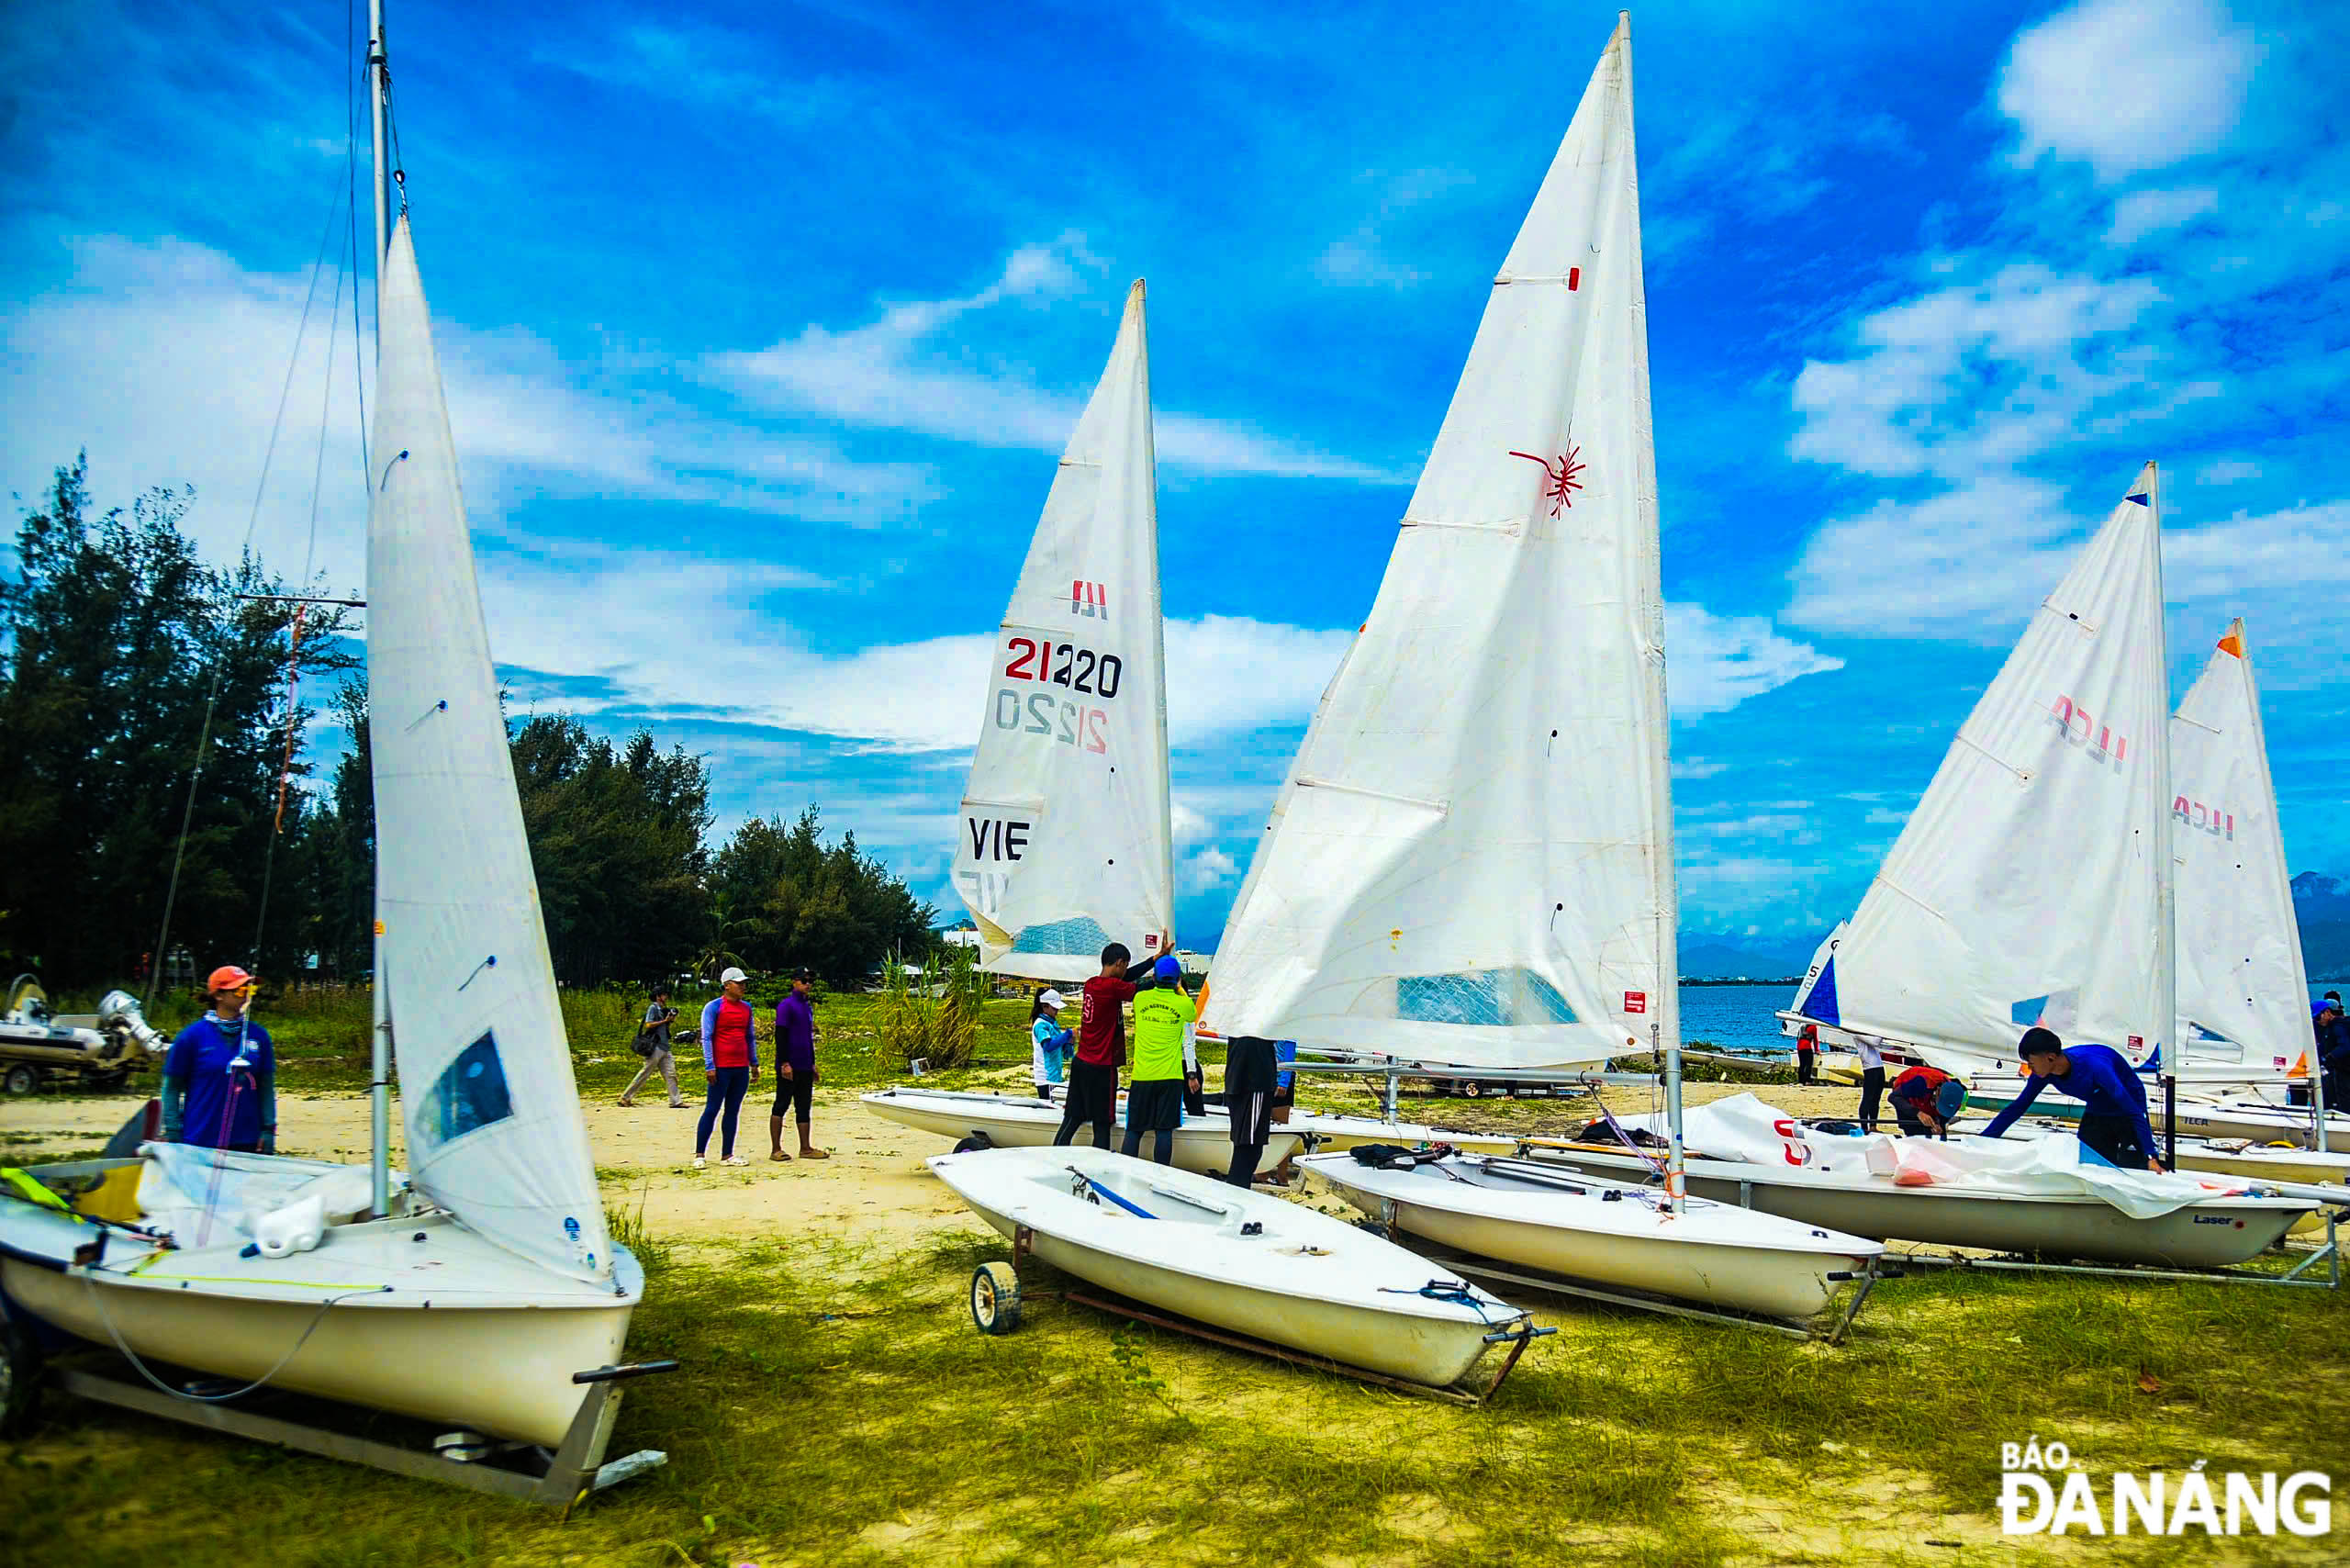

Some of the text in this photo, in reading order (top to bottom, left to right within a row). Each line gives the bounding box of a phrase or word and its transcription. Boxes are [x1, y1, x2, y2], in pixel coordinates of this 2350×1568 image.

[1005, 637, 1122, 698] 21220
[968, 817, 1030, 860] VIE
[1808, 965, 1819, 978] 5
[2193, 1214, 2233, 1225] Laser
